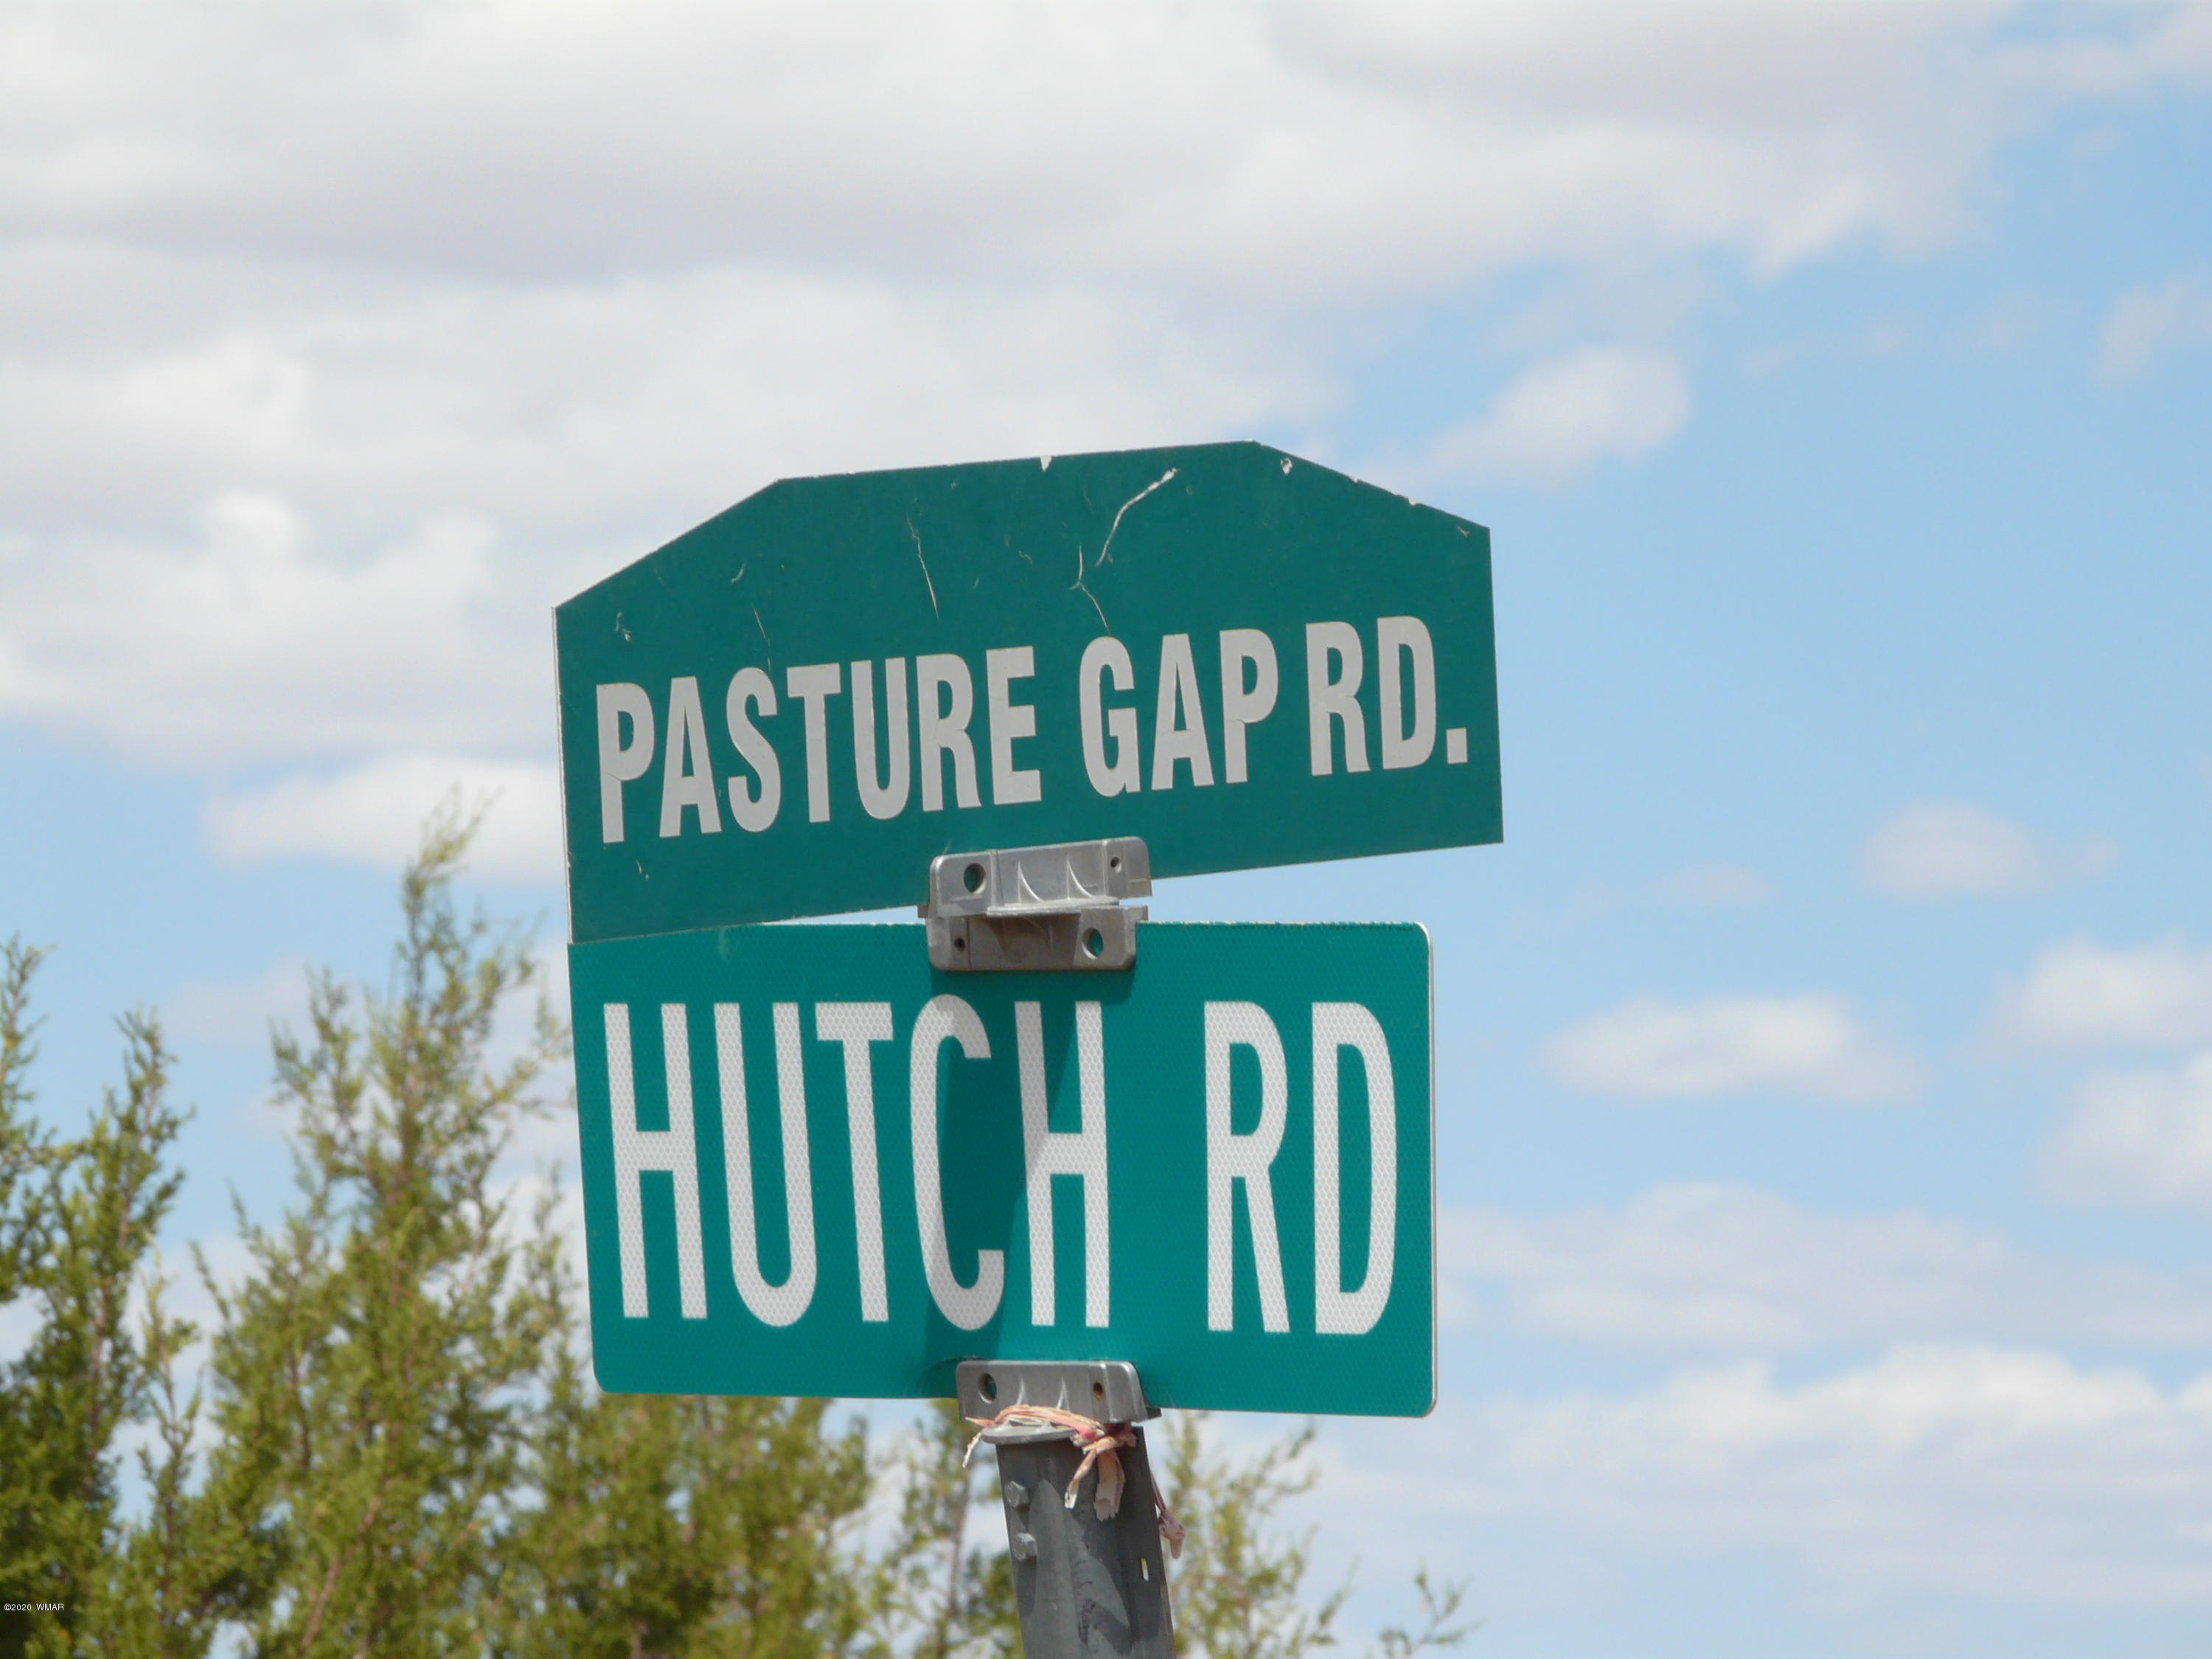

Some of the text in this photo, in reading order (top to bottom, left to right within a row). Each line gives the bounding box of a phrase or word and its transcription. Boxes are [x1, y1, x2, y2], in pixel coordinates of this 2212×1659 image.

[595, 616, 1469, 844] PASTURE GAP RD.
[602, 995, 1397, 1336] HUTCH RD
